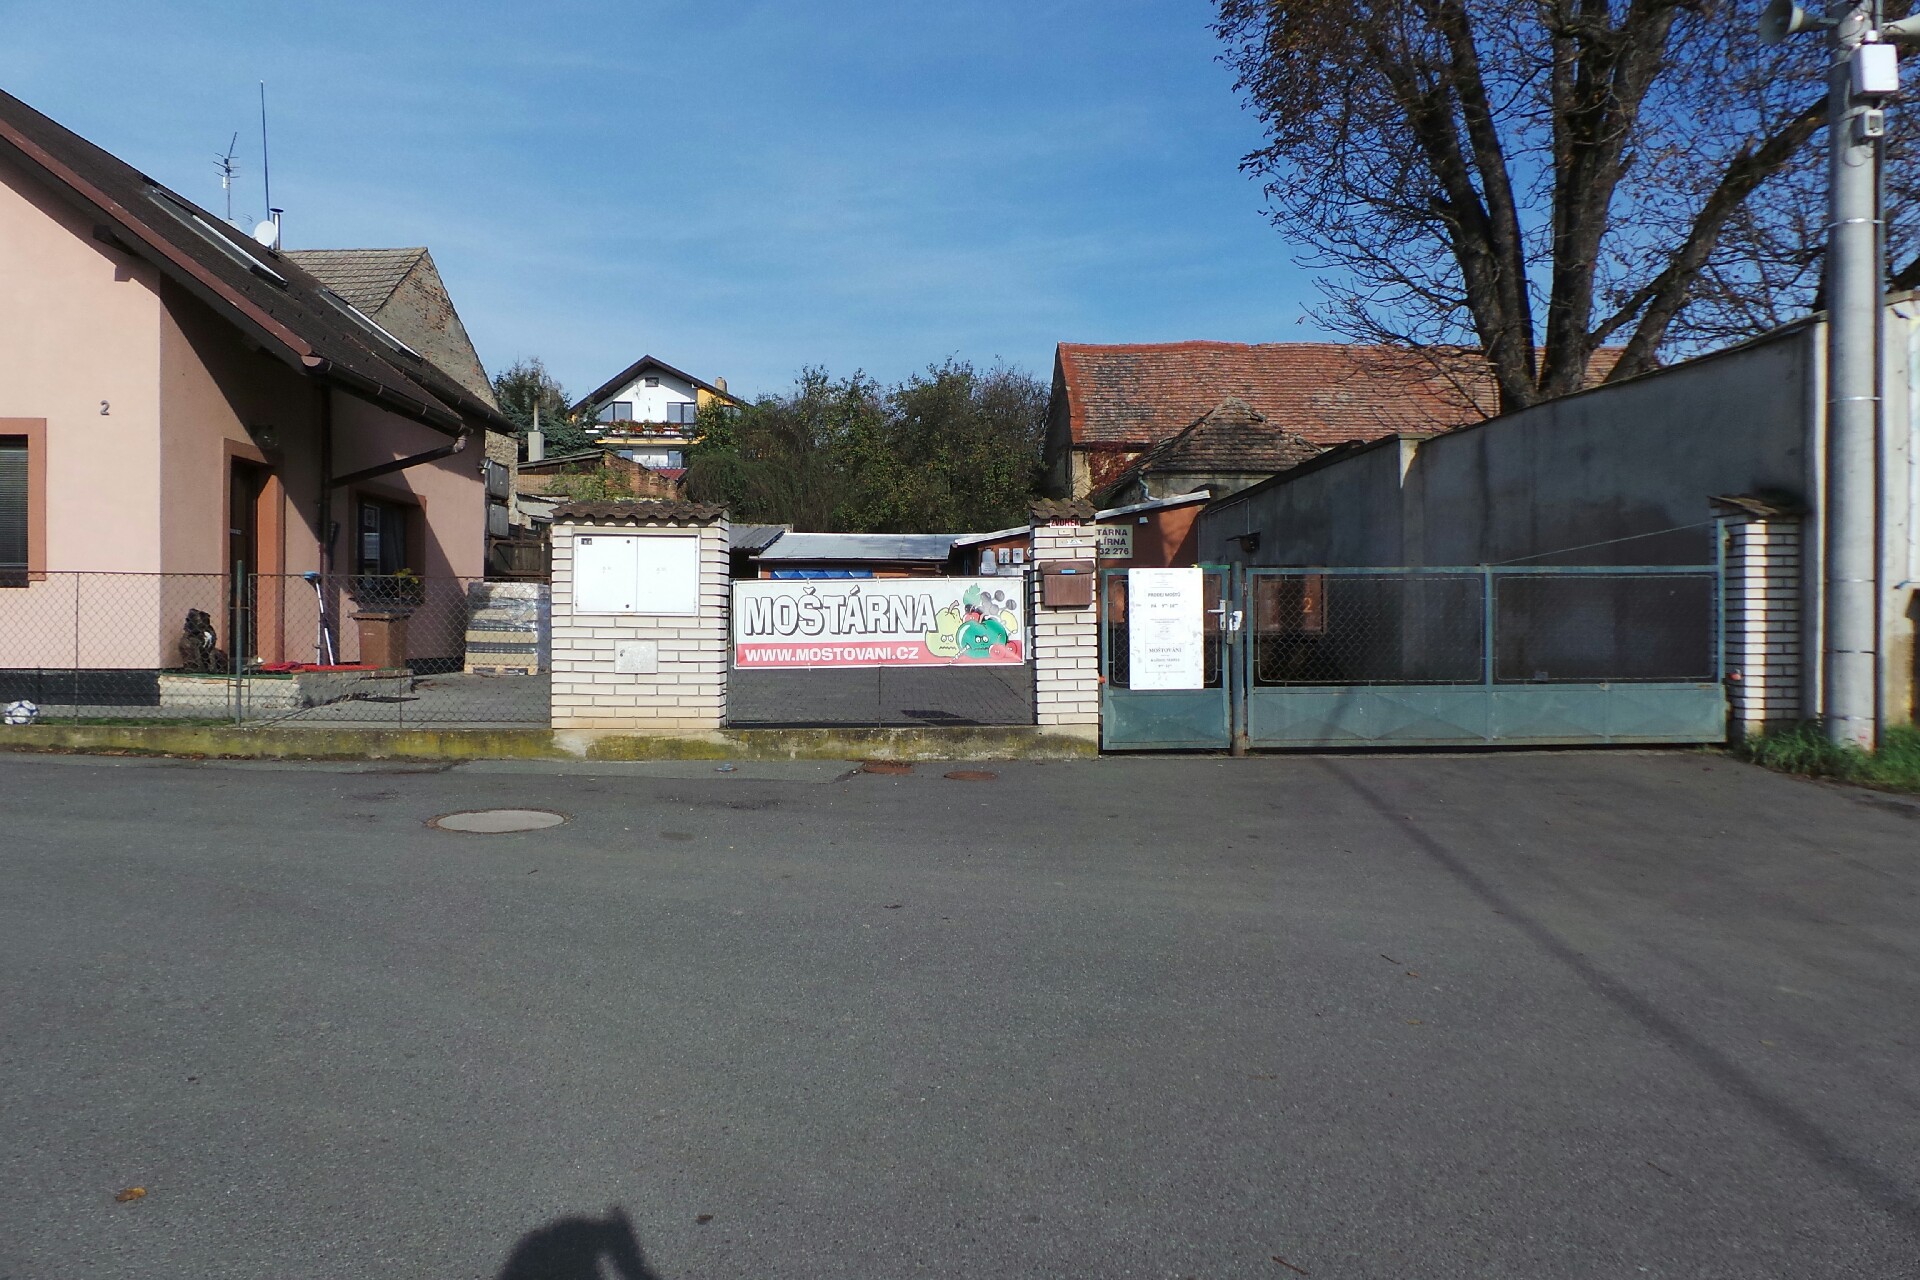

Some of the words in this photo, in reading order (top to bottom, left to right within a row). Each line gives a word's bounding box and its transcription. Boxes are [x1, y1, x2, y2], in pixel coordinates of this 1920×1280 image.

[100, 399, 110, 416] 2
[1050, 517, 1080, 527] ZVONEK
[1112, 547, 1129, 555] 276
[744, 585, 938, 636] MOŠTÁRNA
[745, 647, 919, 662] WWW.MOSTOVANI.CZ
